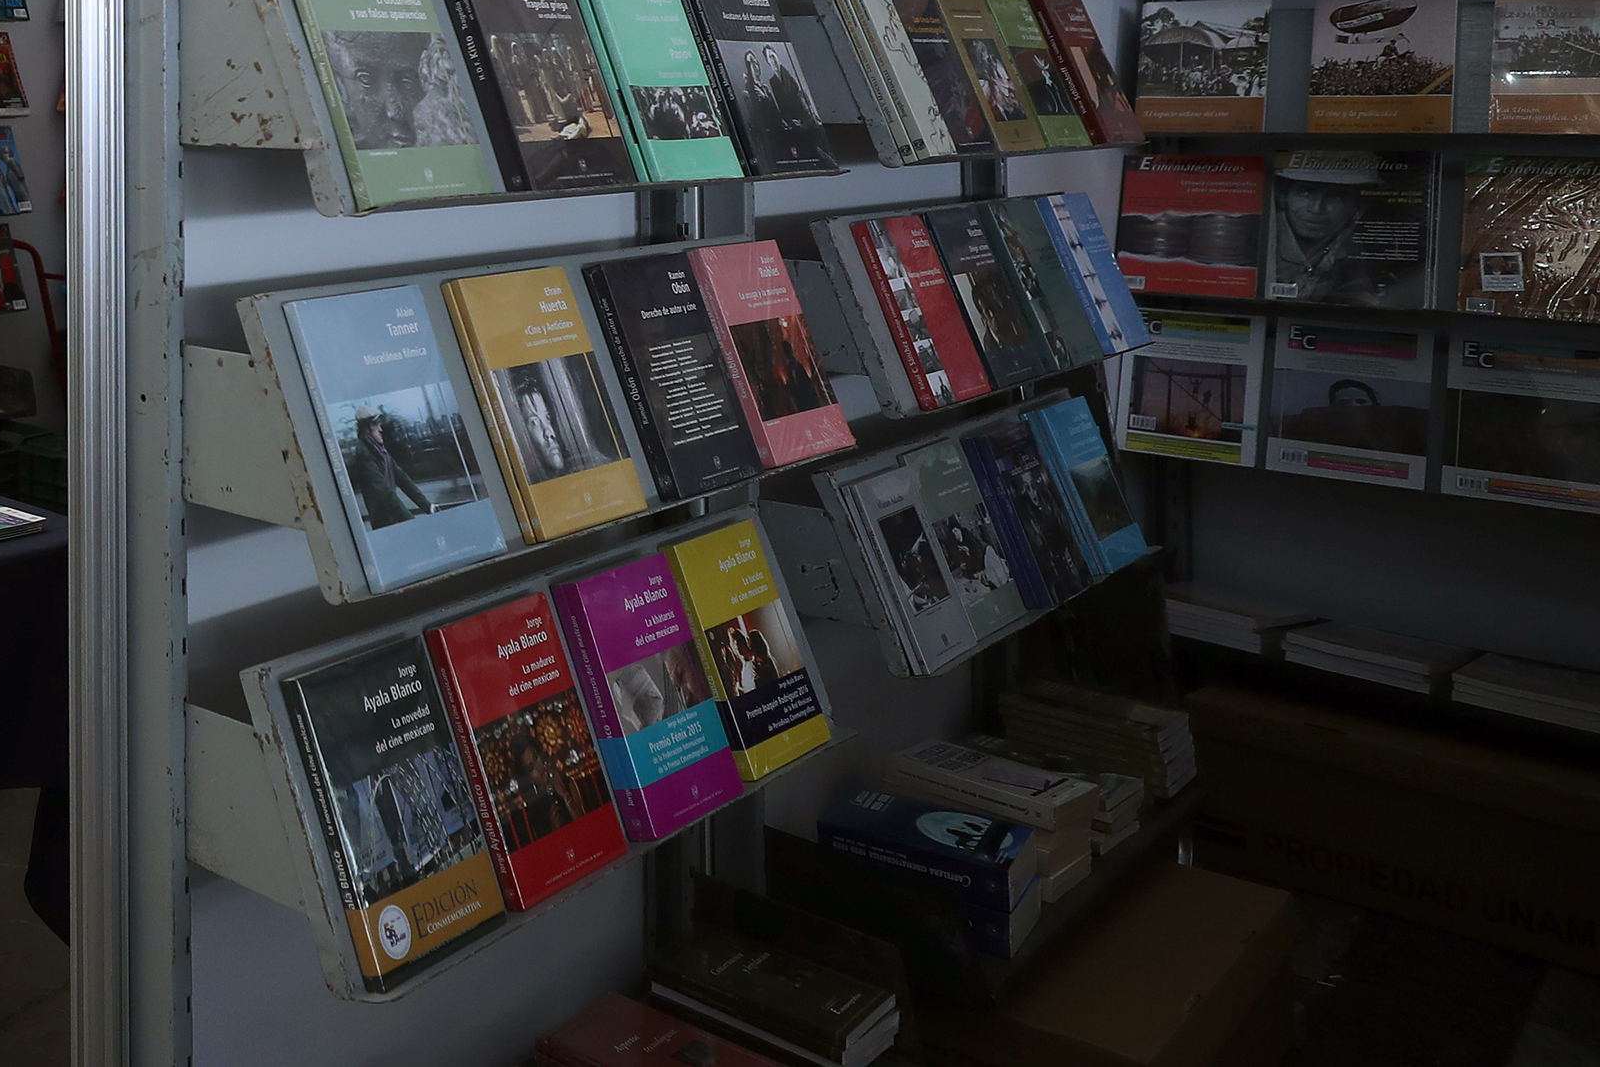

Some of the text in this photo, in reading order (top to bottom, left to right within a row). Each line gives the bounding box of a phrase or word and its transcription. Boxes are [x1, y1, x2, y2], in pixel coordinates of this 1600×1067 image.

[356, 10, 368, 18] sus
[368, 8, 389, 19] falsas
[390, 10, 427, 21] apariencias
[524, 0, 569, 11] Tragedia griega
[1326, 109, 1340, 117] cine
[667, 269, 685, 280] Ramón
[758, 266, 780, 279] Robles
[671, 281, 691, 295] Obón
[396, 306, 415, 319] Alain
[538, 299, 568, 313] Huerta
[640, 307, 663, 320] Derecho
[663, 306, 670, 316] de
[670, 304, 683, 314] autor
[687, 302, 697, 312] cine
[386, 320, 419, 337] Tanner
[364, 346, 427, 366] Miscelánea fílmica
[902, 341, 916, 367] Sánchez
[718, 548, 757, 573] Ayala Blanco
[648, 574, 663, 587] Jorge
[624, 586, 668, 613] Ayala Blanco
[731, 584, 769, 605] del cine mexicano
[525, 616, 542, 629] Jorge
[645, 617, 652, 628] La
[497, 630, 548, 660] Ayala Blanco
[634, 624, 680, 648] del cine mexicano
[397, 663, 417, 678] Jorge
[521, 654, 556, 675] La madurez
[509, 668, 560, 697] del cine mexicano
[363, 679, 422, 714] Ayala Blanco
[746, 706, 764, 721] Premio
[798, 684, 809, 698] 2016
[391, 703, 431, 729] La novedad
[375, 722, 435, 754] del cine mexicano
[648, 723, 703, 754] Premio Fénix 2015
[333, 850, 349, 890] Blanco
[1263, 830, 1597, 951] PROPIEDAD UNAM
[411, 878, 479, 940] EDICIÓN
[426, 900, 482, 935] CONMEMORATIVA
[613, 1035, 640, 1053] Aspectos
[643, 1029, 677, 1053] tecnológicos
